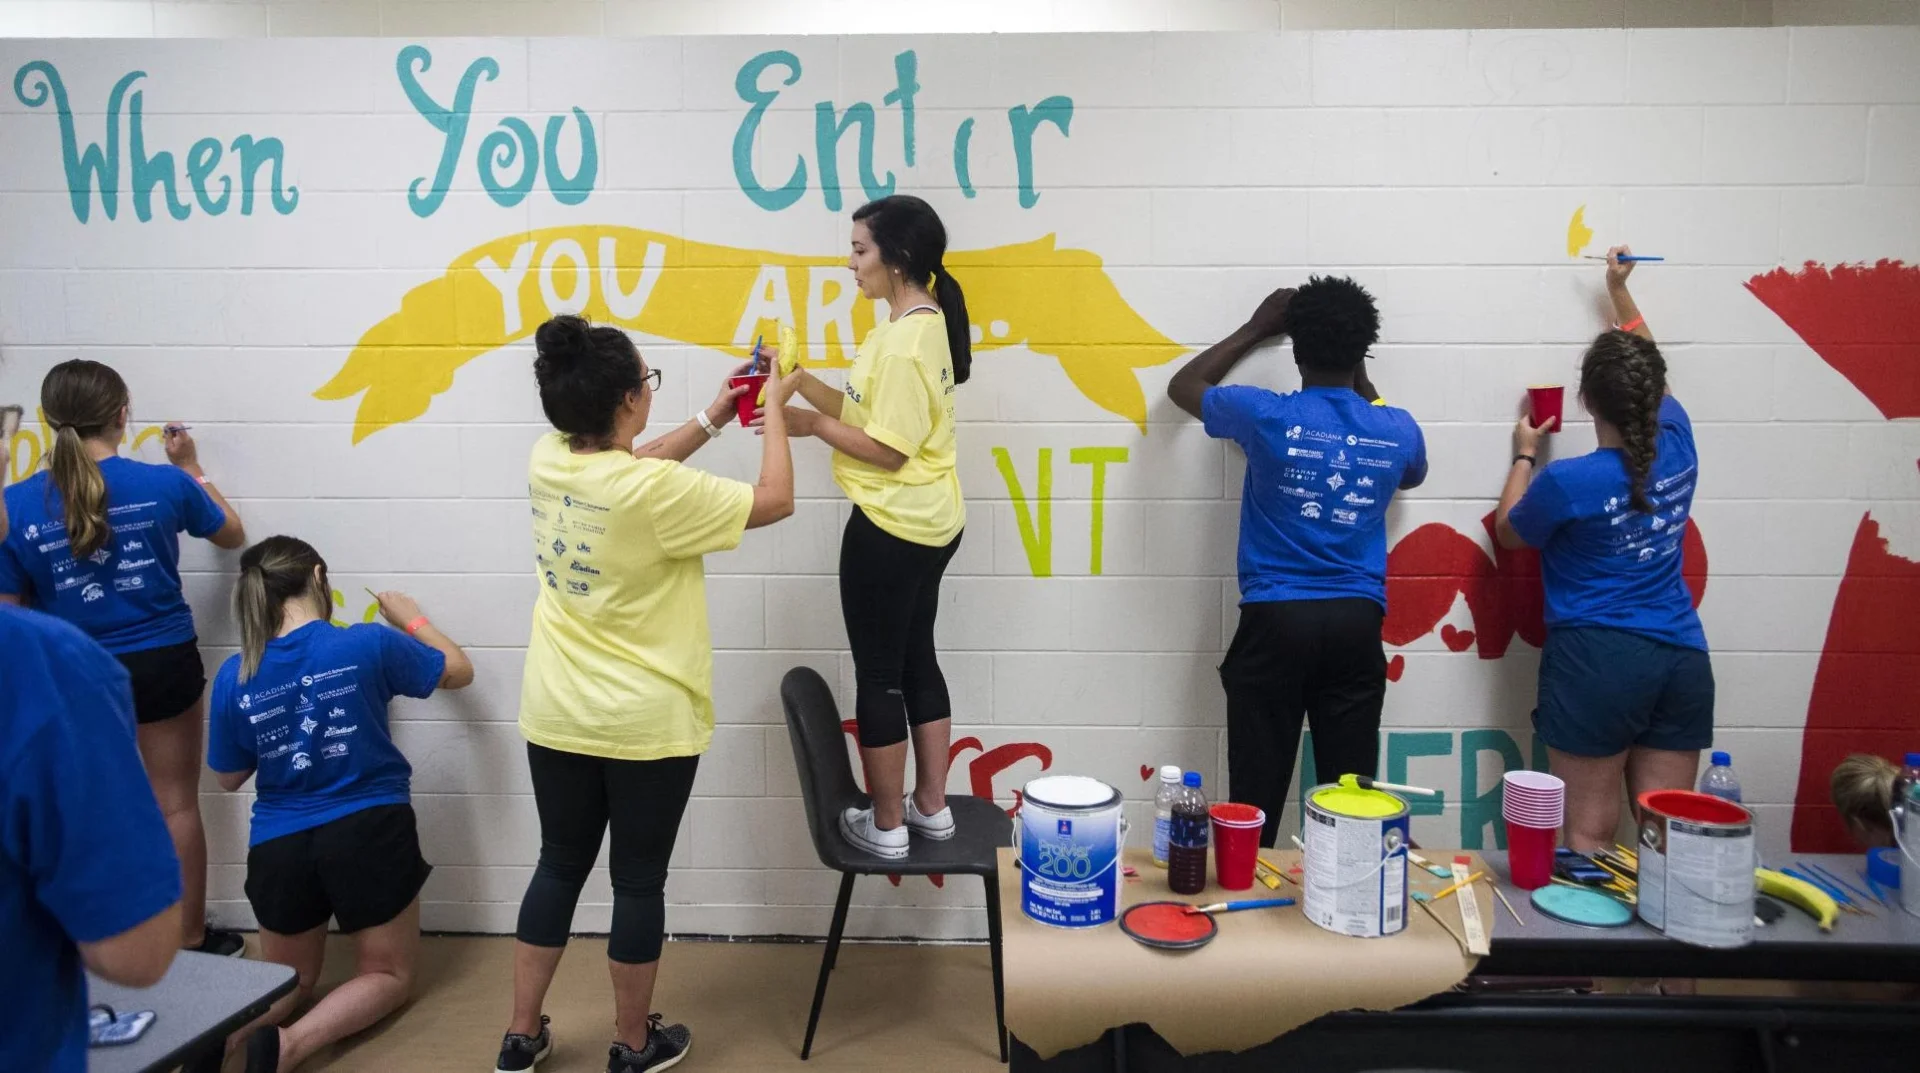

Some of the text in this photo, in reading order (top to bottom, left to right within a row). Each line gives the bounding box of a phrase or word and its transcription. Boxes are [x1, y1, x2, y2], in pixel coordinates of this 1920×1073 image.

[14, 60, 298, 224] When
[397, 45, 598, 218] You
[473, 237, 666, 336] YOU
[1305, 430, 1342, 441] ACADIANA
[254, 681, 298, 699] ACADIANA
[1300, 729, 1551, 850] ER
[1038, 852, 1092, 878] 200
